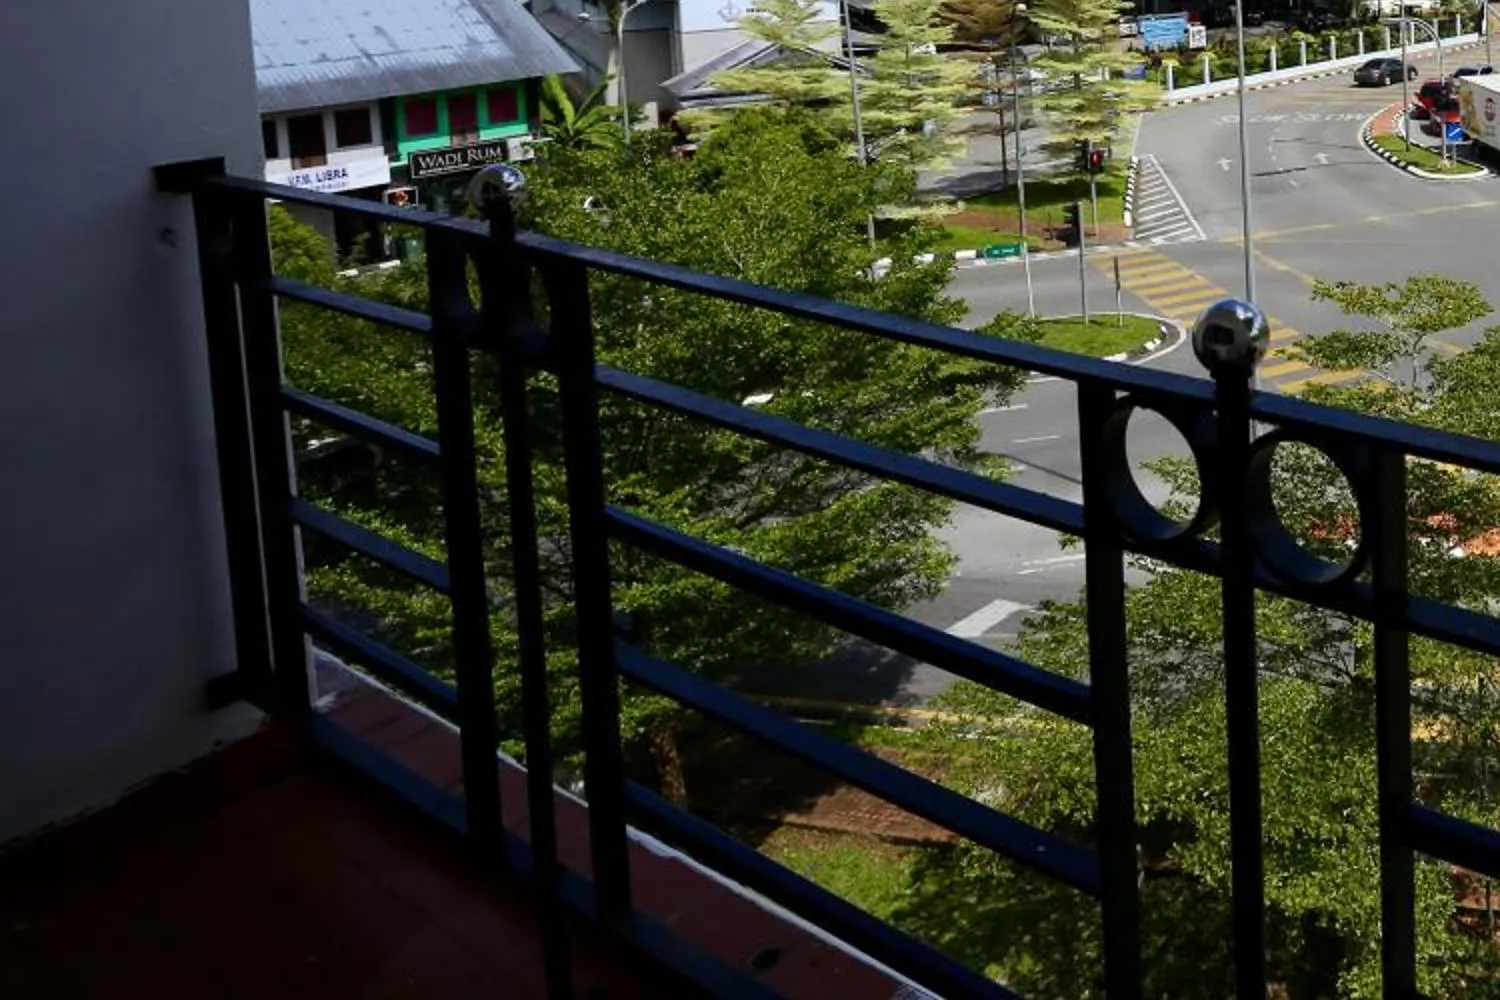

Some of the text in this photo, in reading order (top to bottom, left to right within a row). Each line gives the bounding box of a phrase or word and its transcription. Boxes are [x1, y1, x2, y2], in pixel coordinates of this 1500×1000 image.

[418, 146, 503, 169] WADI RUM
[315, 167, 350, 183] LIBRA
